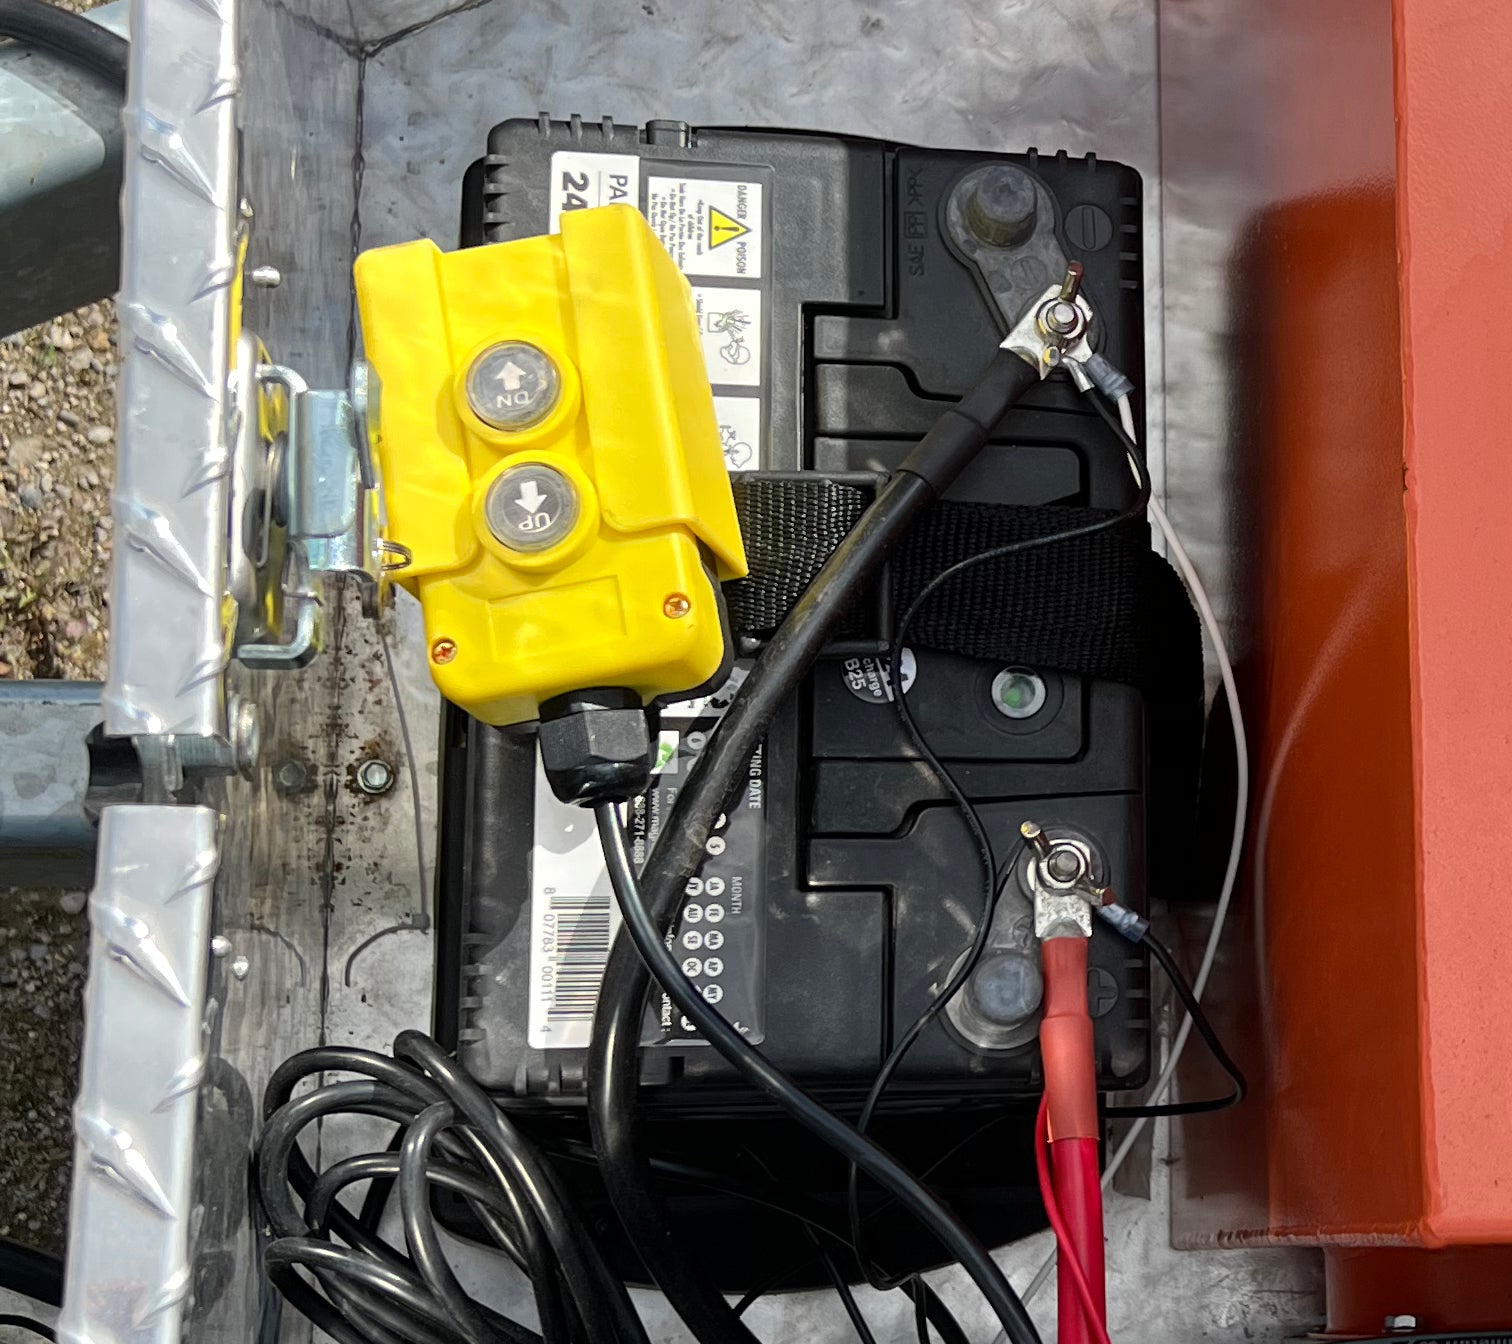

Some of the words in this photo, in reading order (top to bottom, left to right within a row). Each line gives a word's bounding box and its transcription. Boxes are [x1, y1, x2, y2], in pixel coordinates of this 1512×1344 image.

[609, 174, 628, 206] PA
[737, 185, 747, 219] DANGER
[737, 242, 746, 273] POISON
[496, 390, 529, 408] DN
[518, 512, 552, 532] UP
[844, 658, 866, 689] B25
[863, 658, 882, 697] charge
[749, 779, 761, 808] DATE
[544, 887, 555, 895] 8
[732, 877, 742, 914] MONTH
[543, 914, 554, 953] 07783
[541, 966, 553, 1002] 00111
[661, 993, 672, 1026] ontact
